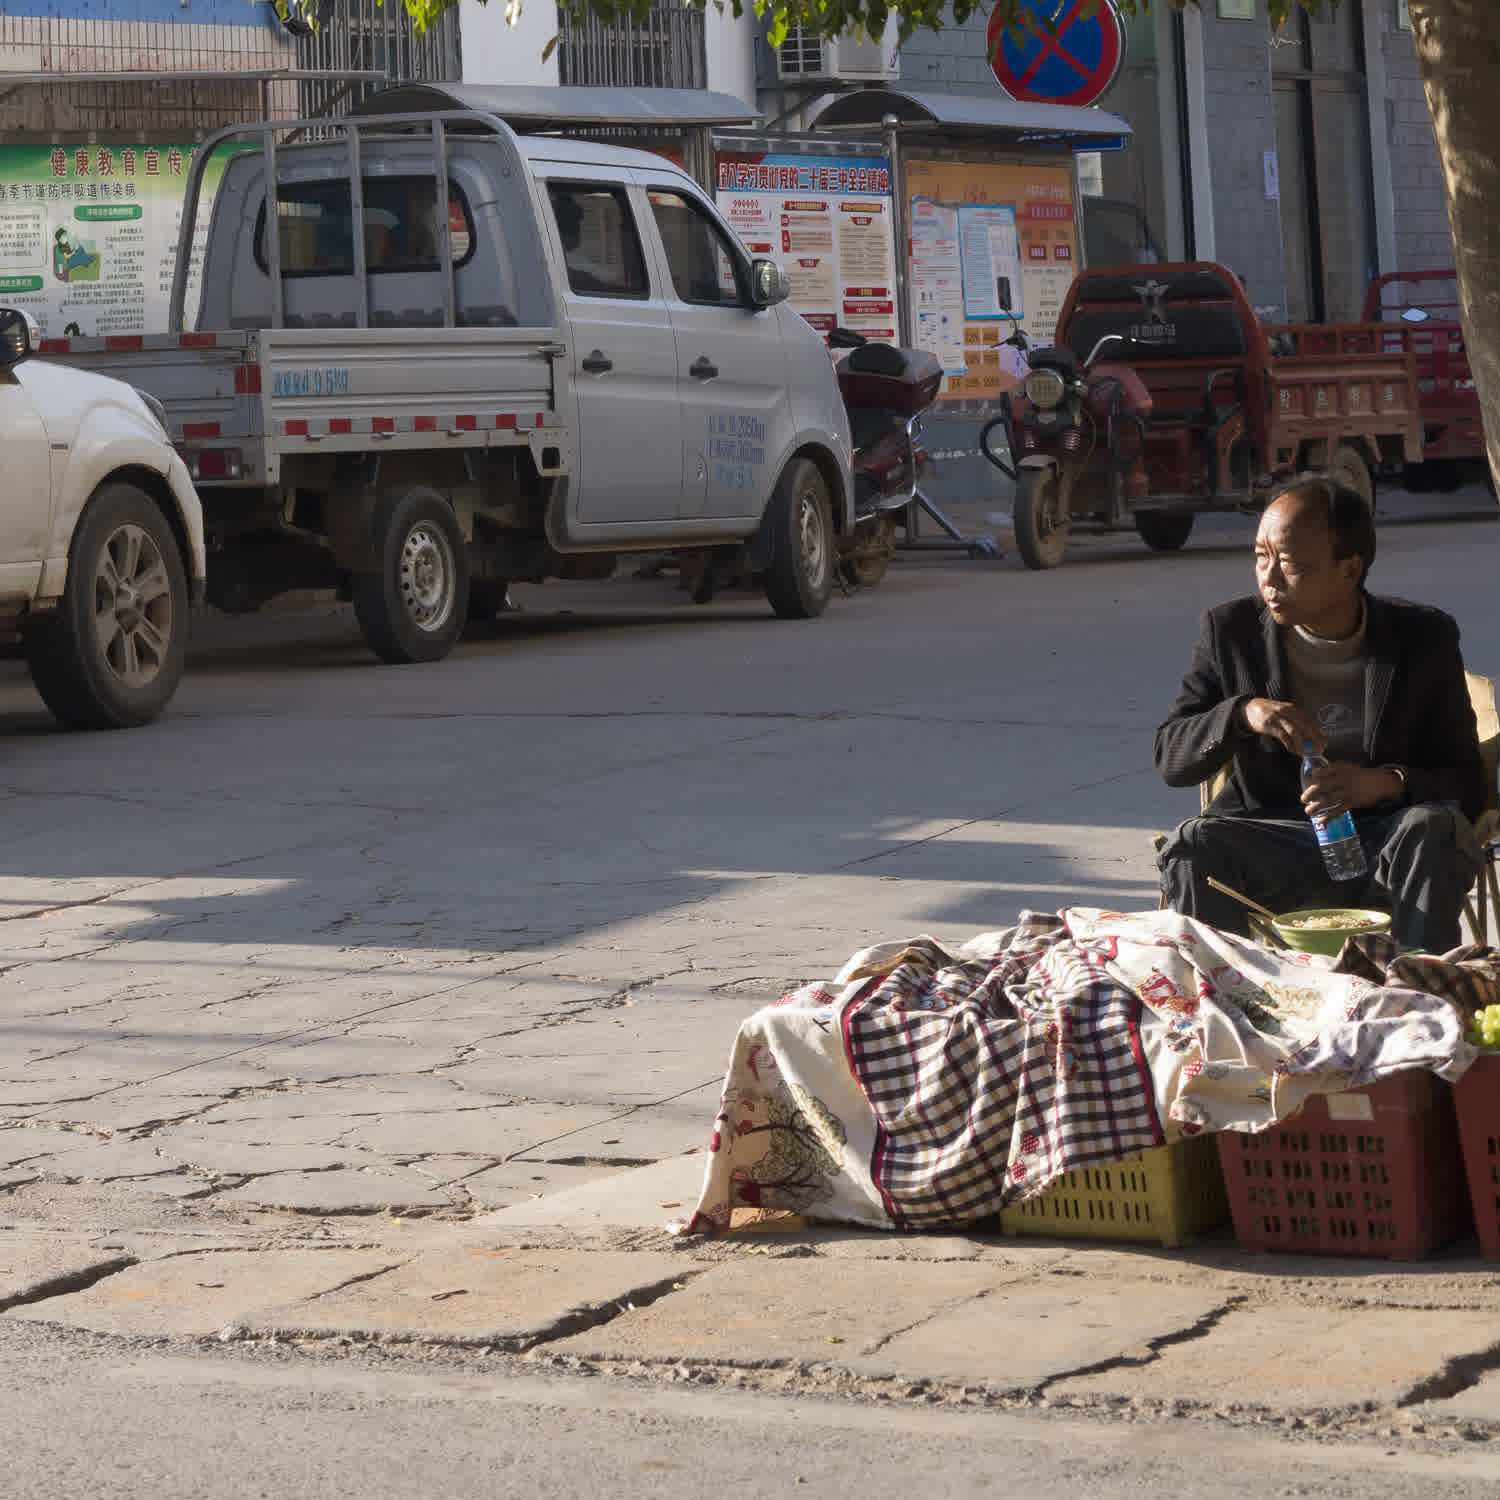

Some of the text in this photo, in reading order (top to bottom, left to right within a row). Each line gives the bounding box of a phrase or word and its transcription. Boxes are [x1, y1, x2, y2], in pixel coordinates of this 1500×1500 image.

[719, 162, 888, 193] 深入学习贯彻党的二十届三中全会精神
